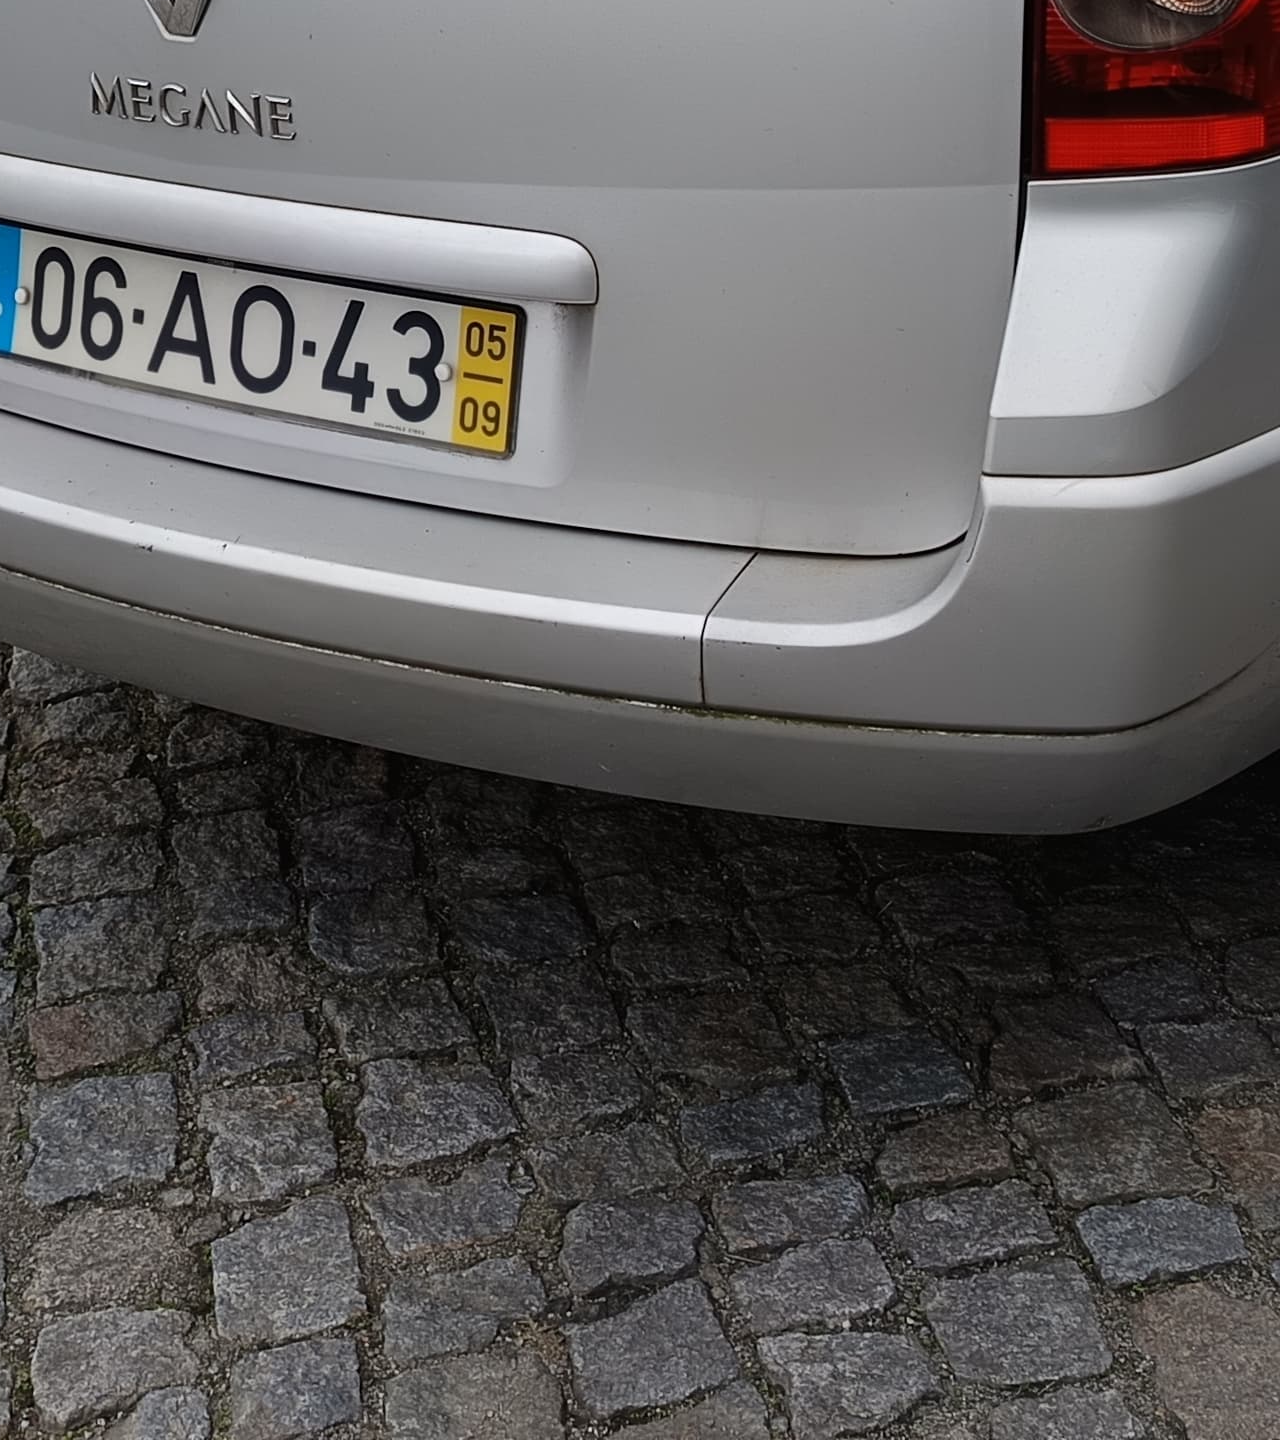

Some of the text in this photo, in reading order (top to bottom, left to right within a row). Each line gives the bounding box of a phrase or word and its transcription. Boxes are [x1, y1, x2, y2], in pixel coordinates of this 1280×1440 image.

[89, 71, 297, 140] MEGANE
[465, 320, 507, 362] 05
[458, 395, 501, 438] 09
